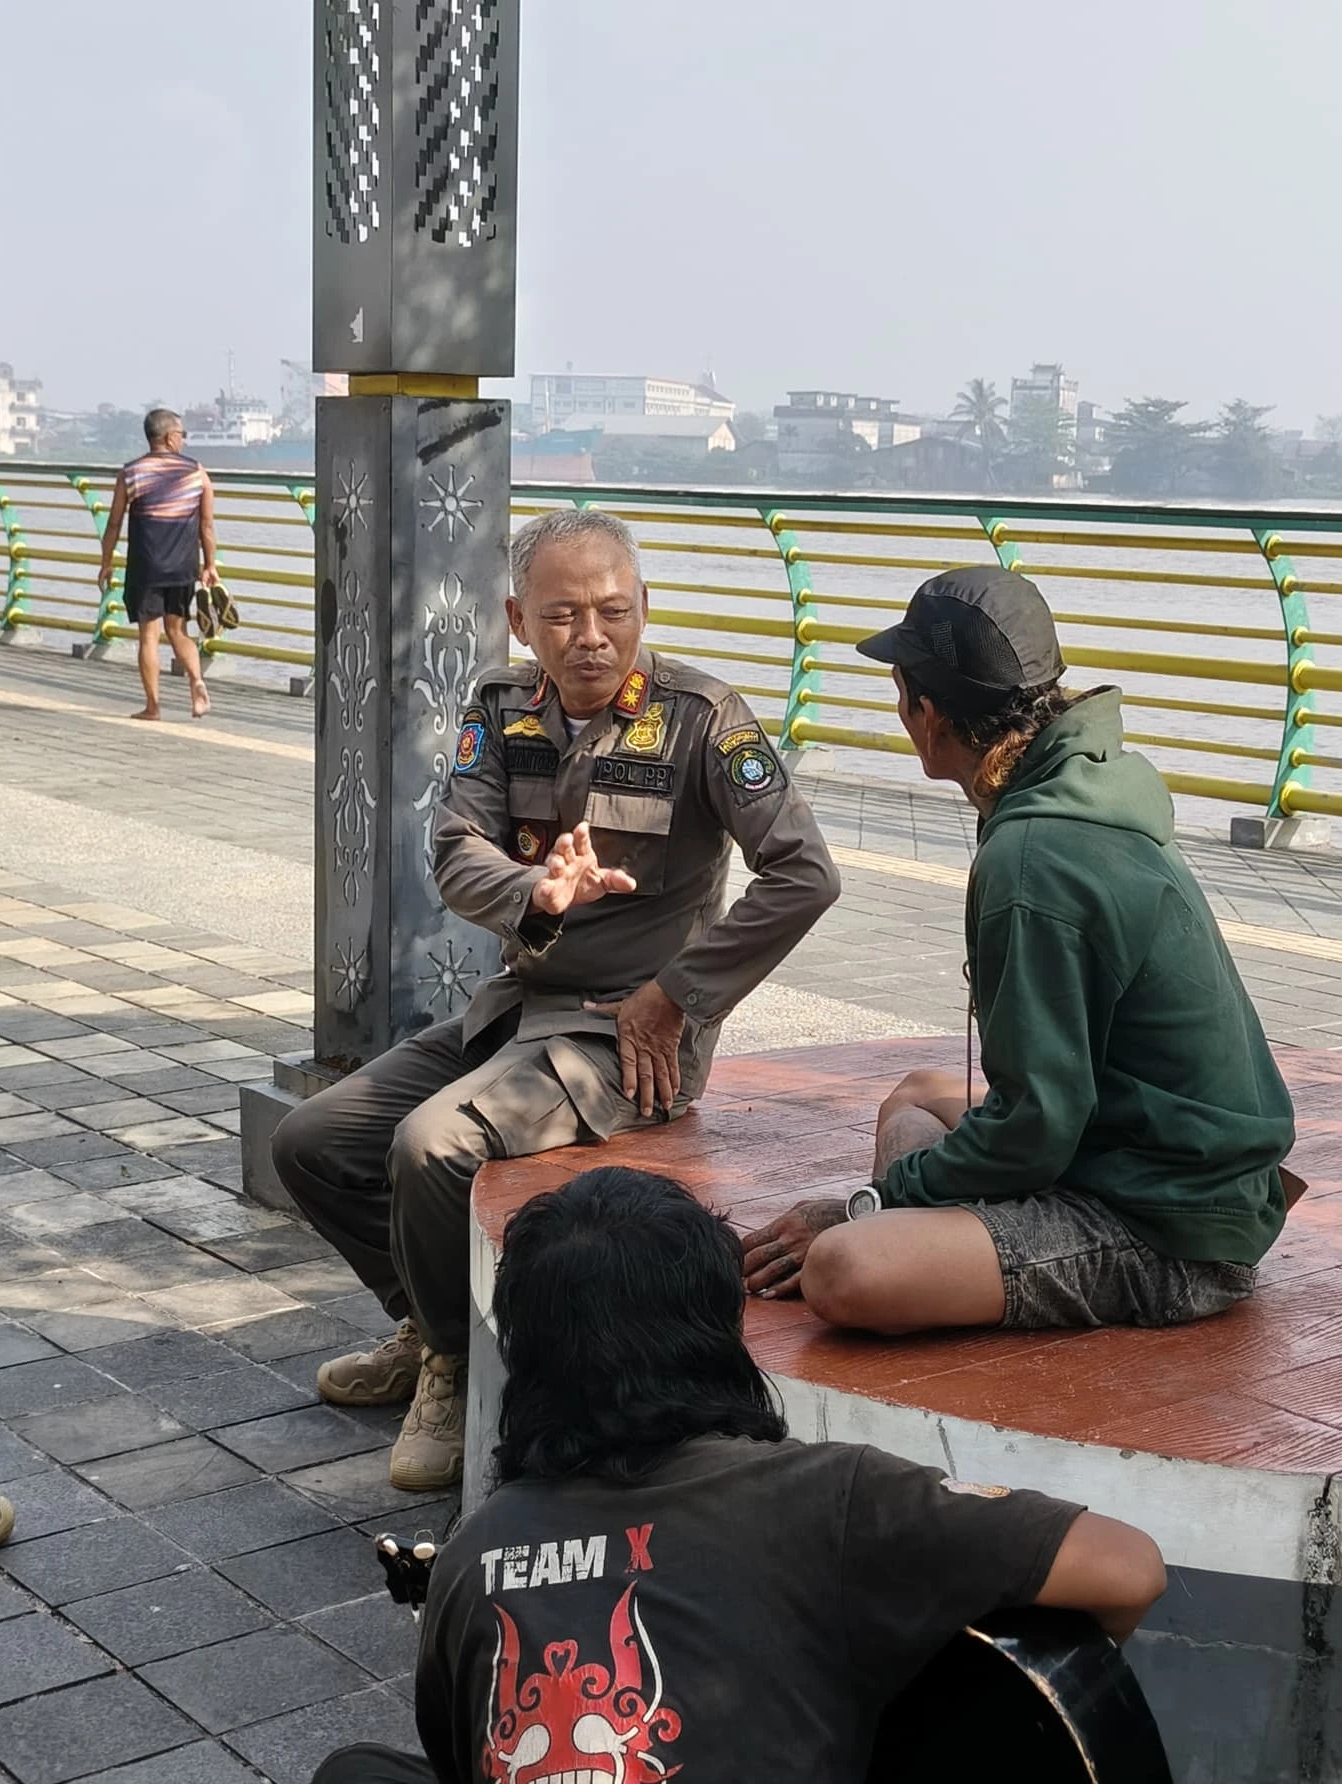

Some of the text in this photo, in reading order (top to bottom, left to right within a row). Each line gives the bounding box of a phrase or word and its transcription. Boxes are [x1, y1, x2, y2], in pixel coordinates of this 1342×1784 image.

[603, 760, 667, 786] POL PP
[480, 1523, 655, 1596] TEAM X
